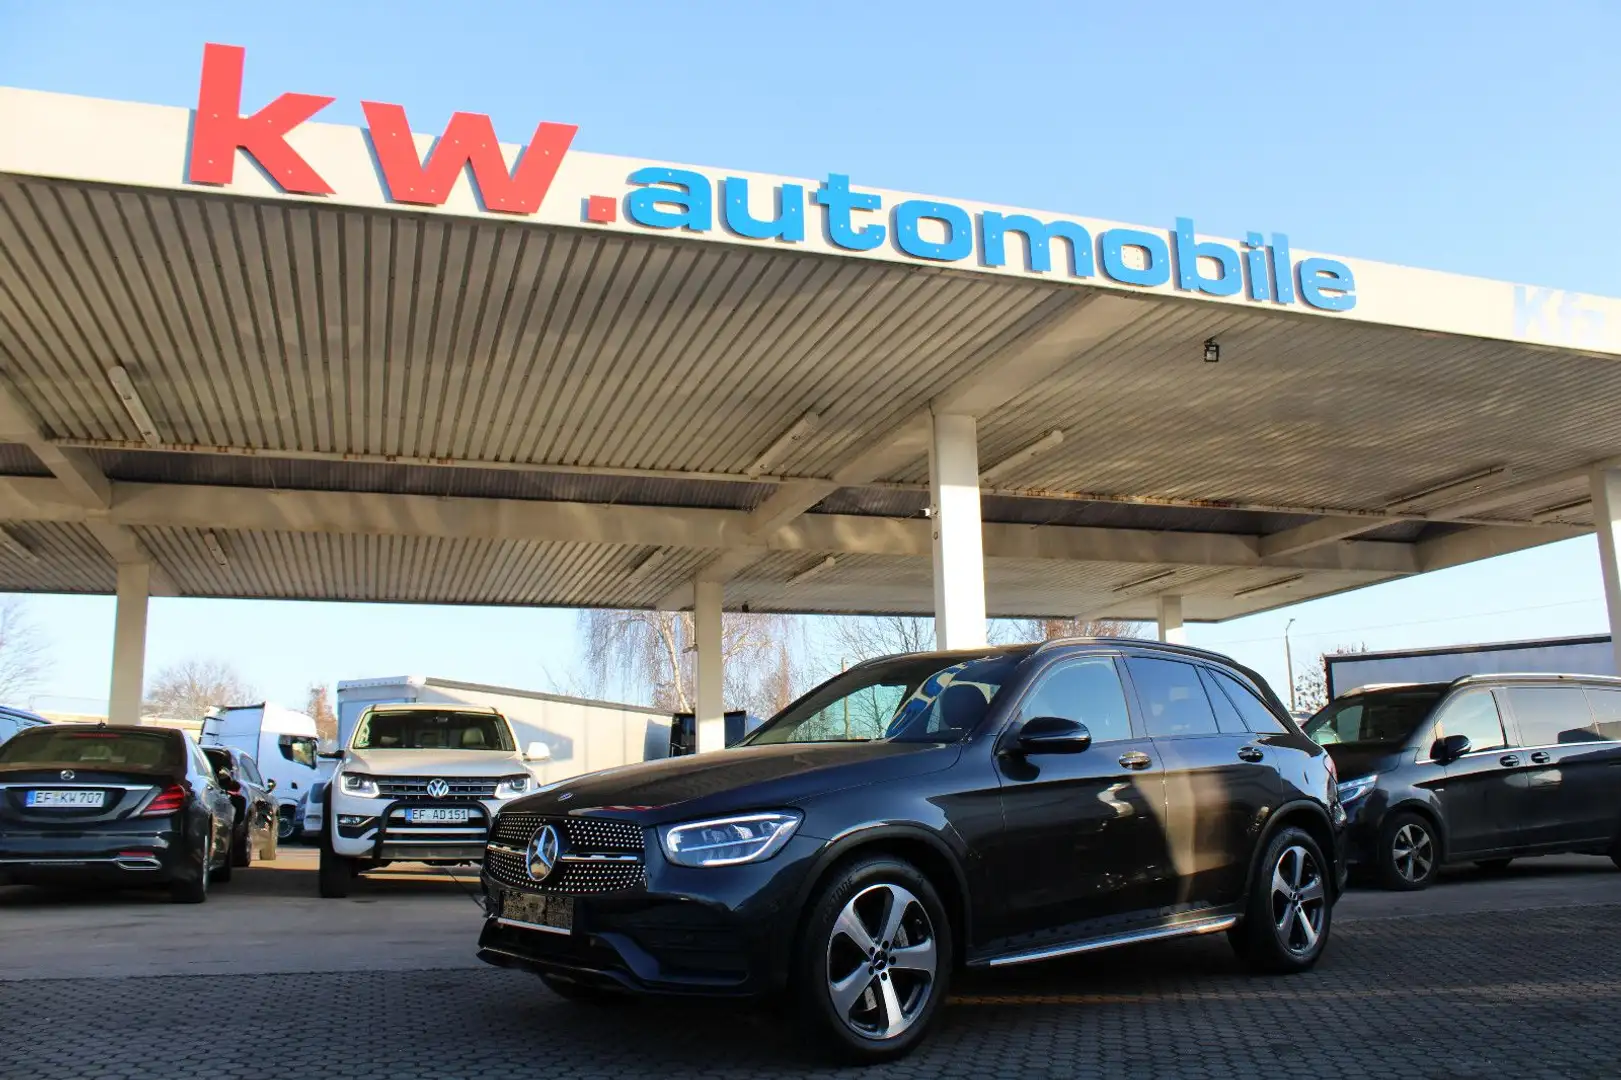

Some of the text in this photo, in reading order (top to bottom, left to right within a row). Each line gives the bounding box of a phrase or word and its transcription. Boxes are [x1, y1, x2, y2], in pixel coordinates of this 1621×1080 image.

[35, 791, 52, 804] EF
[80, 792, 102, 804] 707
[412, 809, 425, 820] EF
